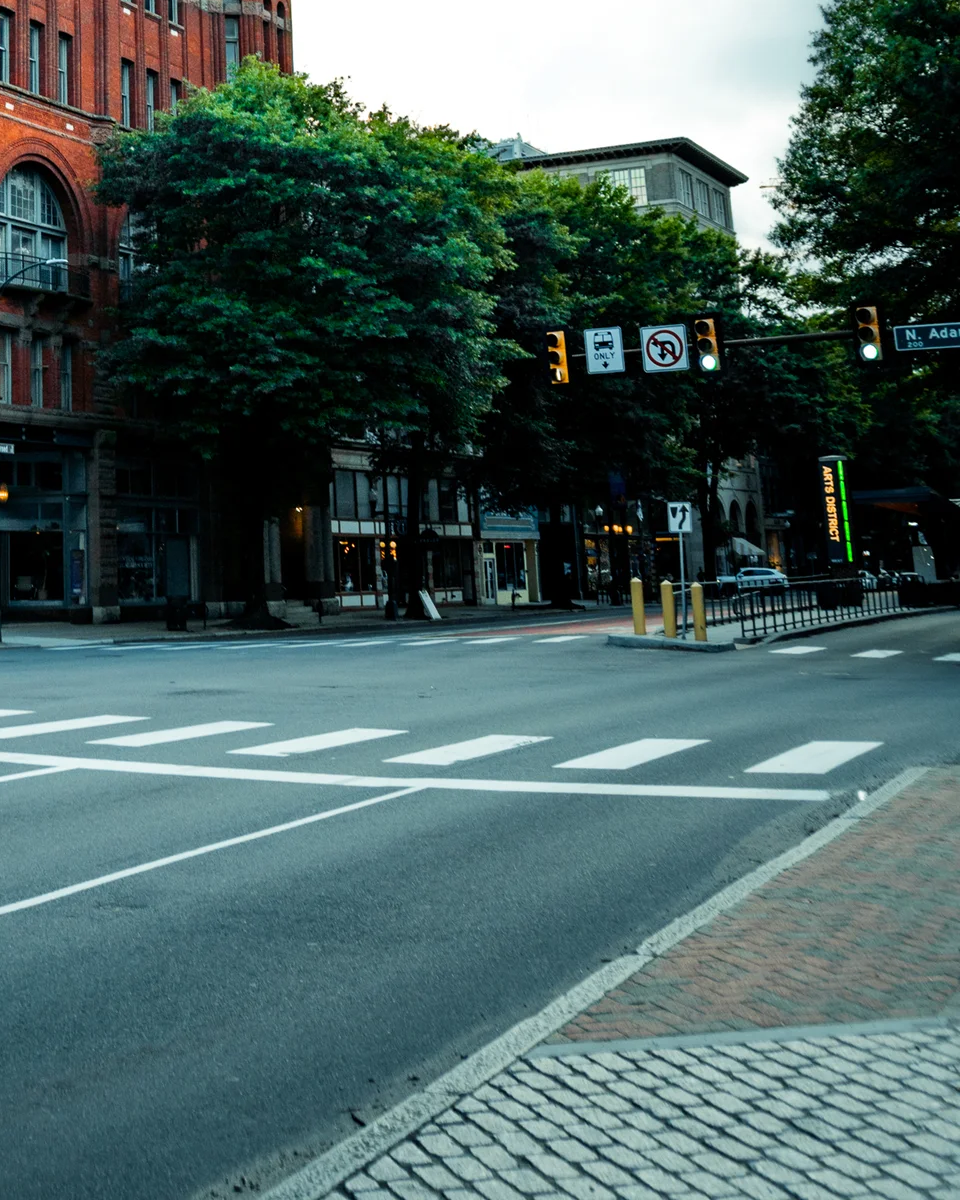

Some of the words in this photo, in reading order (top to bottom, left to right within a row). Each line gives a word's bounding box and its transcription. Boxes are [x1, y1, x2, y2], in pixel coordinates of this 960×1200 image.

[906, 329, 922, 340] N.
[594, 352, 615, 361] ONLY
[822, 465, 834, 494] ARTS
[825, 496, 840, 542] DISTRICT
